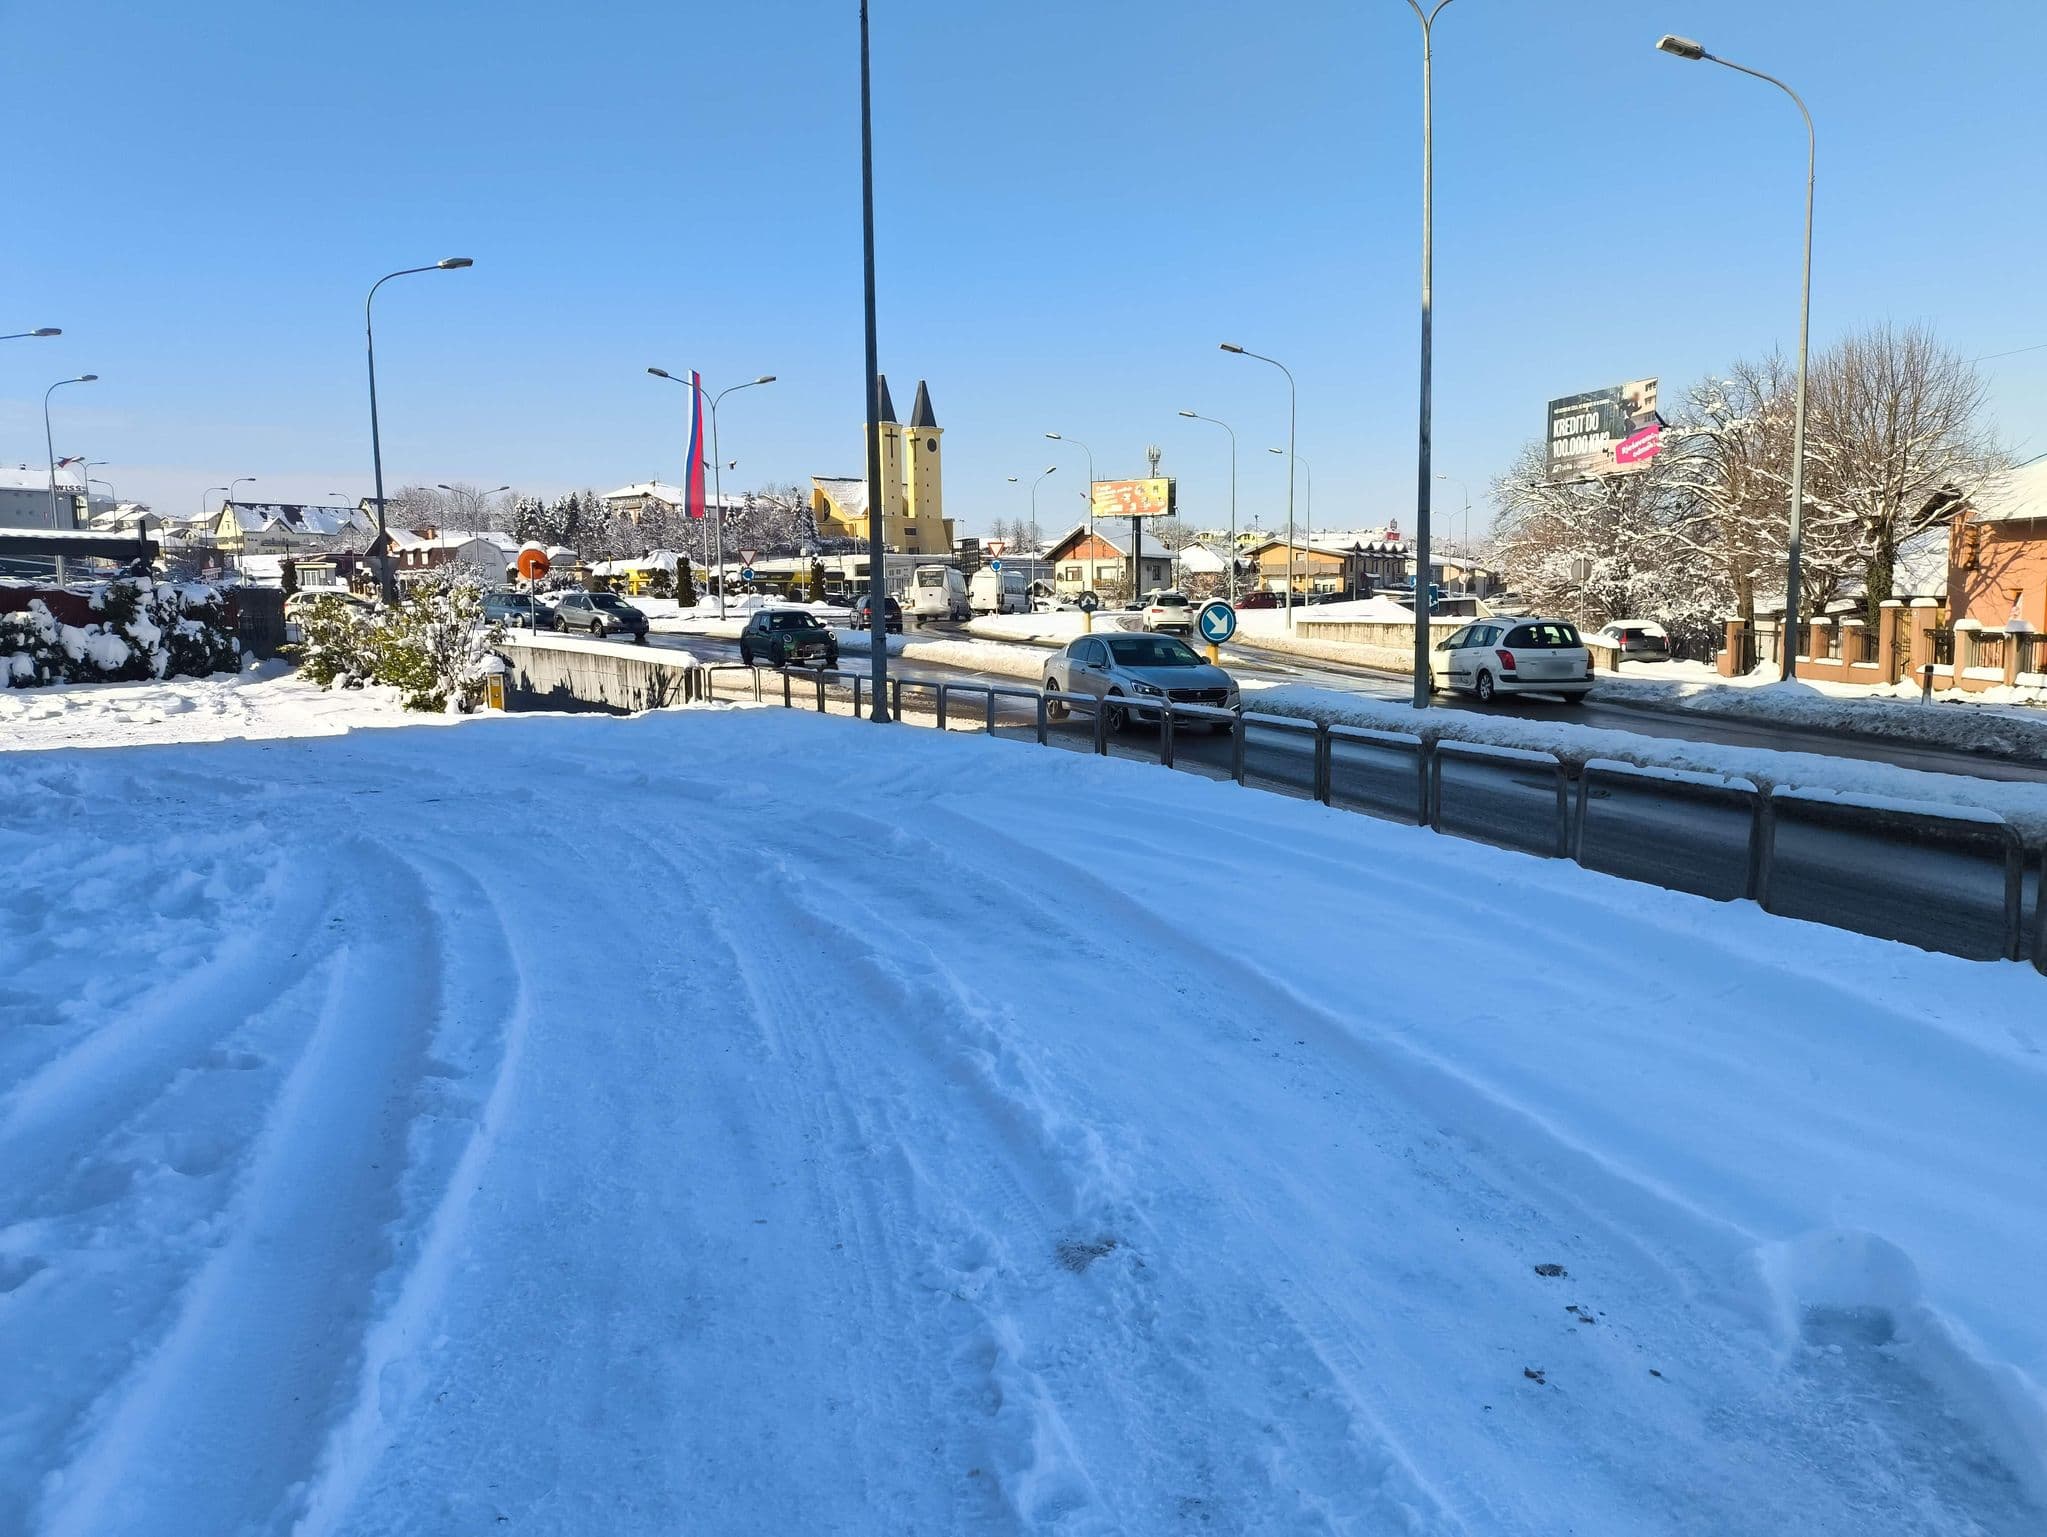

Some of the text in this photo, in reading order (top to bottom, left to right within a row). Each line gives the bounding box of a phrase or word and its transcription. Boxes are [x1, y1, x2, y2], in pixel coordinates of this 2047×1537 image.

[1553, 411, 1600, 438] KREDIT DO
[1552, 431, 1610, 458] 100.000 KM?
